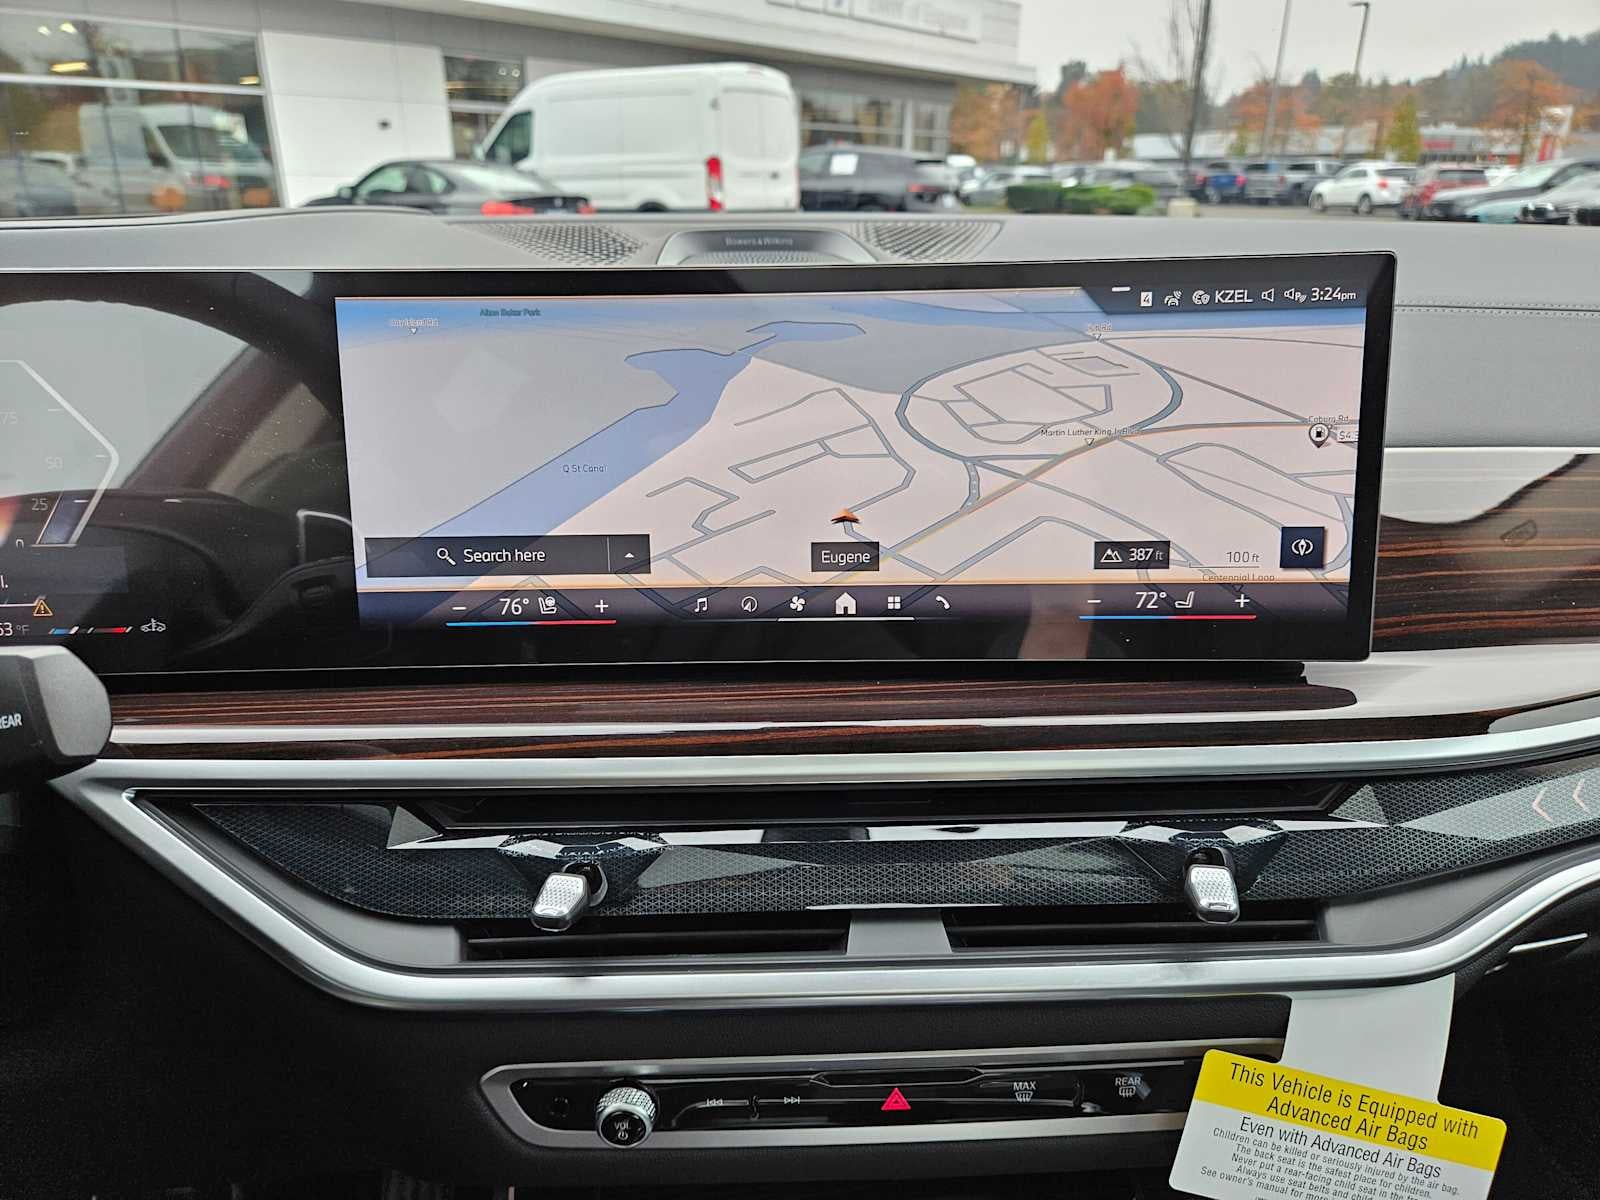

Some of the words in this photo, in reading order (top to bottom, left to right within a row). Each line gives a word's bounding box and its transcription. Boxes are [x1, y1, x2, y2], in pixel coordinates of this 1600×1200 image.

[1215, 291, 1253, 304] KZEL
[1311, 287, 1357, 303] 3:24pm
[1308, 415, 1336, 424] Coburg
[1041, 428, 1066, 438] Martin
[1067, 428, 1092, 438] Luther
[1094, 427, 1112, 438] King
[45, 456, 63, 470] 50
[563, 464, 570, 473] Q
[572, 464, 581, 473] St
[583, 464, 608, 473] Canal
[31, 498, 48, 511] 25
[464, 549, 511, 563] Search
[515, 548, 546, 562] here
[821, 550, 870, 566] Eugene
[1129, 548, 1154, 562] 387
[1155, 549, 1164, 561] ft
[1227, 551, 1250, 563] 100
[1252, 552, 1260, 563] ft
[1202, 573, 1250, 582] Centennial
[1252, 573, 1276, 582] Loop
[500, 598, 529, 615] 76°
[1136, 592, 1167, 609] 72°
[1013, 1081, 1036, 1091] MAX
[1115, 1077, 1141, 1087] REAR
[1231, 1062, 1264, 1087] This
[1272, 1072, 1332, 1103] Vehicle
[1337, 1089, 1352, 1108] is
[1358, 1094, 1438, 1129] Equipped
[1443, 1117, 1479, 1139] with
[614, 1120, 630, 1130] VOL
[1267, 1096, 1352, 1131] Advanced
[1355, 1118, 1382, 1139] Air
[1387, 1124, 1429, 1151] Bags
[1240, 1116, 1274, 1138] Even
[1279, 1128, 1308, 1146] with
[1310, 1134, 1381, 1163] Advanced
[1382, 1152, 1405, 1169] Air
[1407, 1156, 1441, 1179] Bags
[1213, 1127, 1250, 1144] Children
[1252, 1138, 1269, 1149] can
[1271, 1141, 1281, 1152] be
[1283, 1144, 1308, 1158] killed
[1310, 1153, 1320, 1162] or
[1322, 1155, 1362, 1173] seriously
[1365, 1165, 1395, 1181] injured
[1397, 1172, 1409, 1185] by
[1411, 1175, 1425, 1187] the
[1427, 1180, 1440, 1190] air
[1441, 1183, 1460, 1196] bag.
[1231, 1153, 1257, 1167] Never
[1259, 1159, 1275, 1171] put
[1284, 1165, 1332, 1186] rear-facing
[1334, 1178, 1356, 1191] child
[1359, 1185, 1377, 1196] seat
[1379, 1190, 1388, 1199] in
[1235, 1144, 1251, 1155] The
[1254, 1148, 1274, 1161] back
[1277, 1155, 1295, 1166] seat
[1298, 1159, 1307, 1168] is
[1309, 1161, 1323, 1172] the
[1325, 1166, 1352, 1180] safest
[1354, 1173, 1376, 1186] place
[1379, 1178, 1392, 1189] for
[1394, 1183, 1431, 1199] children.
[1200, 1166, 1217, 1178] See
[1219, 1170, 1253, 1186] owner's
[1256, 1181, 1288, 1195] manual
[1290, 1188, 1304, 1199] for
[1236, 1165, 1267, 1180] Always
[1270, 1175, 1286, 1184] use
[1288, 1178, 1306, 1189] seat
[1309, 1182, 1330, 1195] belts
[1332, 1189, 1349, 1199] and
